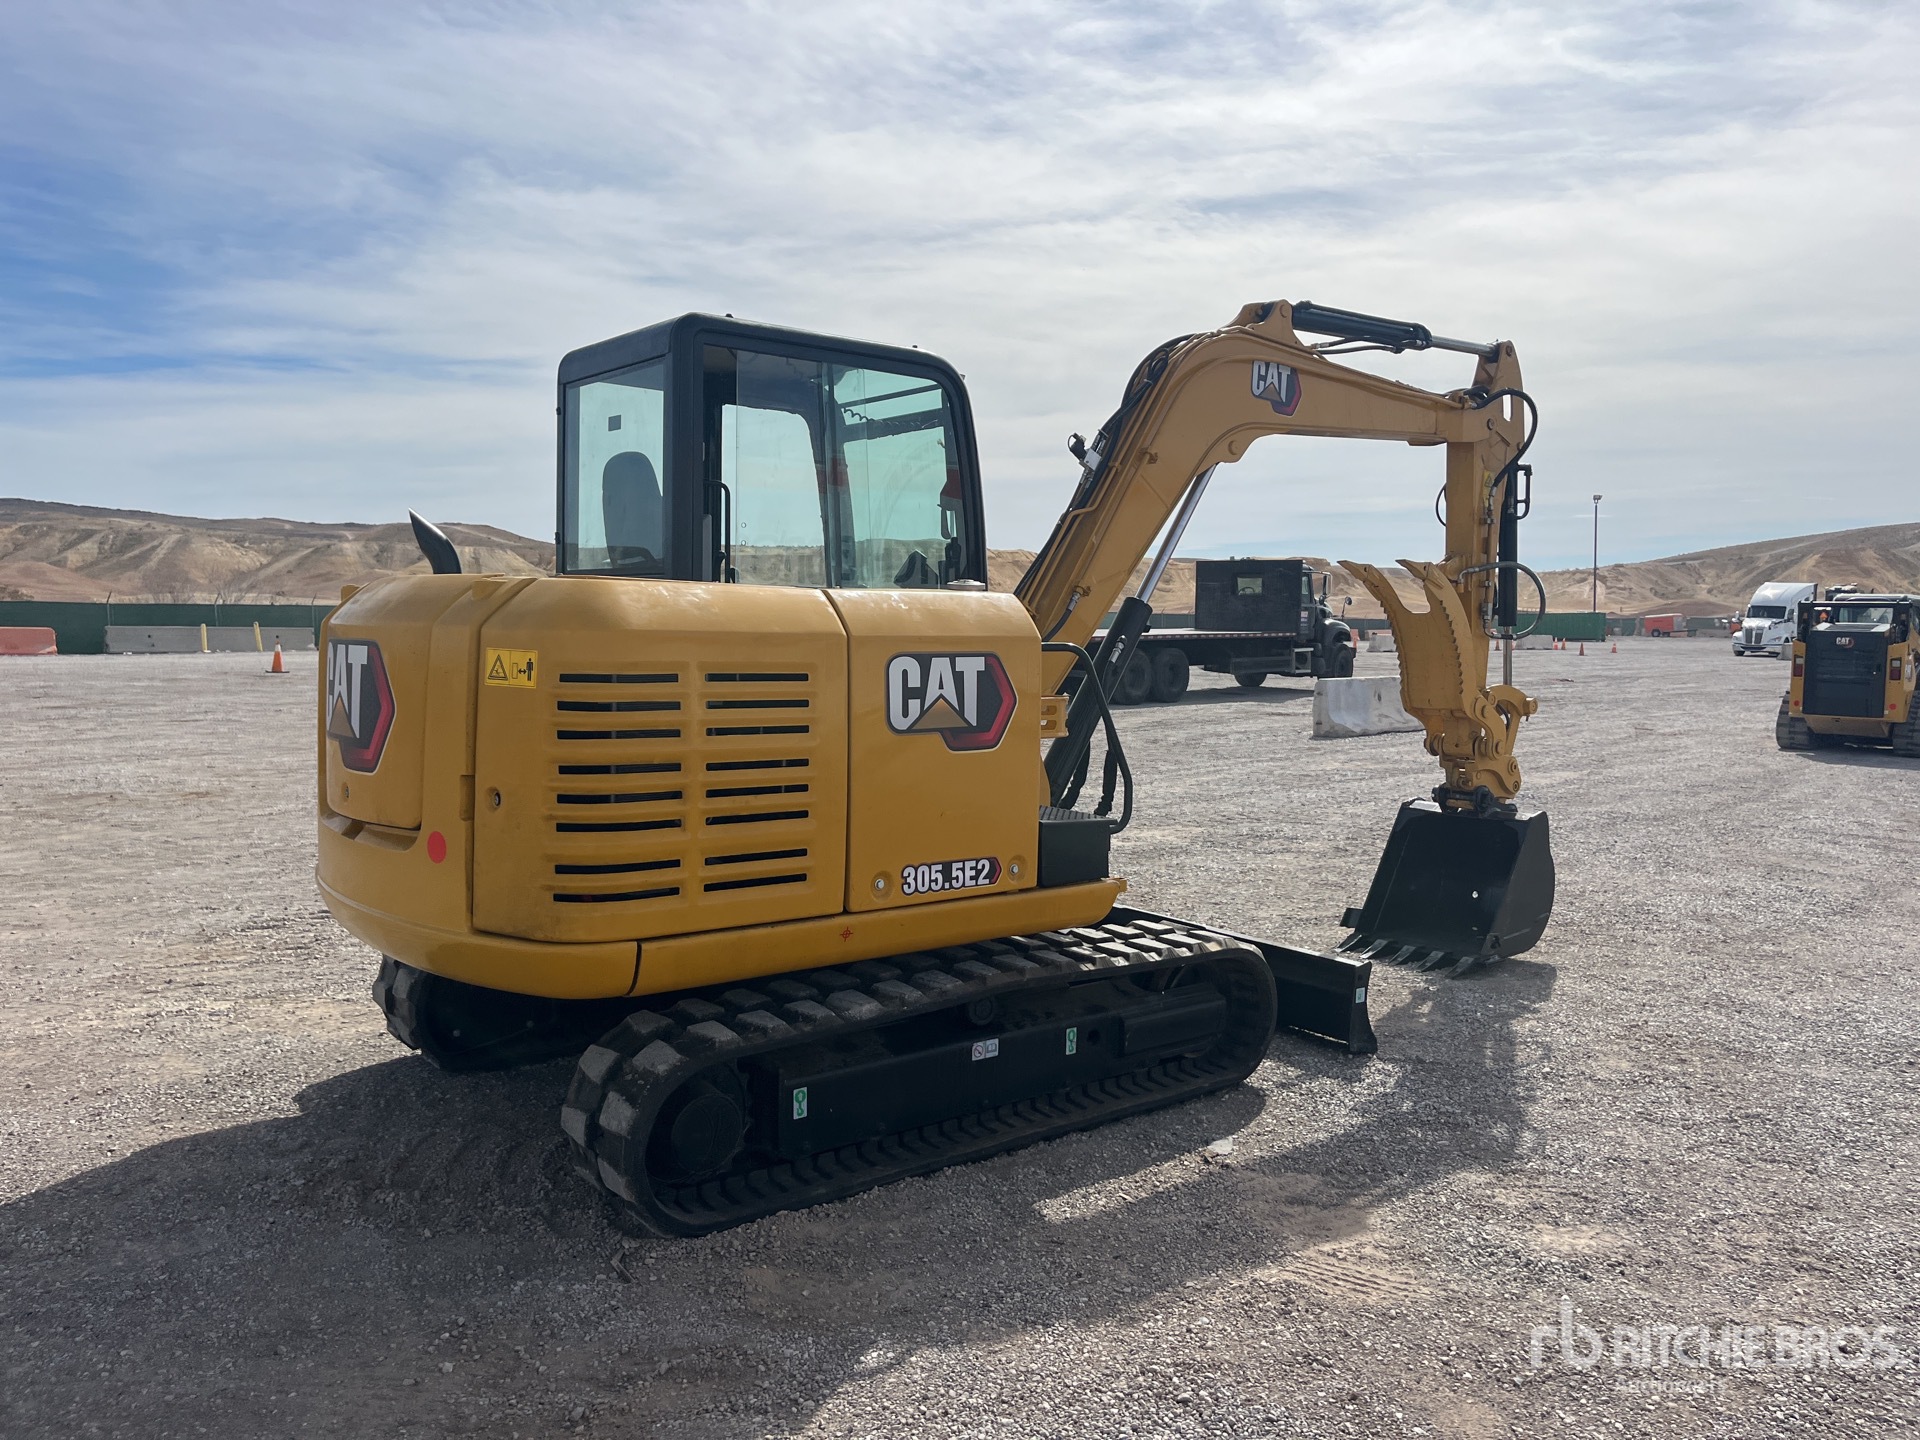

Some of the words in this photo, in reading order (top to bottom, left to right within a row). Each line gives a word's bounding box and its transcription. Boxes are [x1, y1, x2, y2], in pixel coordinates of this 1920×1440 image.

[1252, 360, 1291, 402] CAT
[1836, 636, 1850, 645] CAT
[888, 656, 985, 730] CAT
[902, 858, 990, 894] 305.5E2
